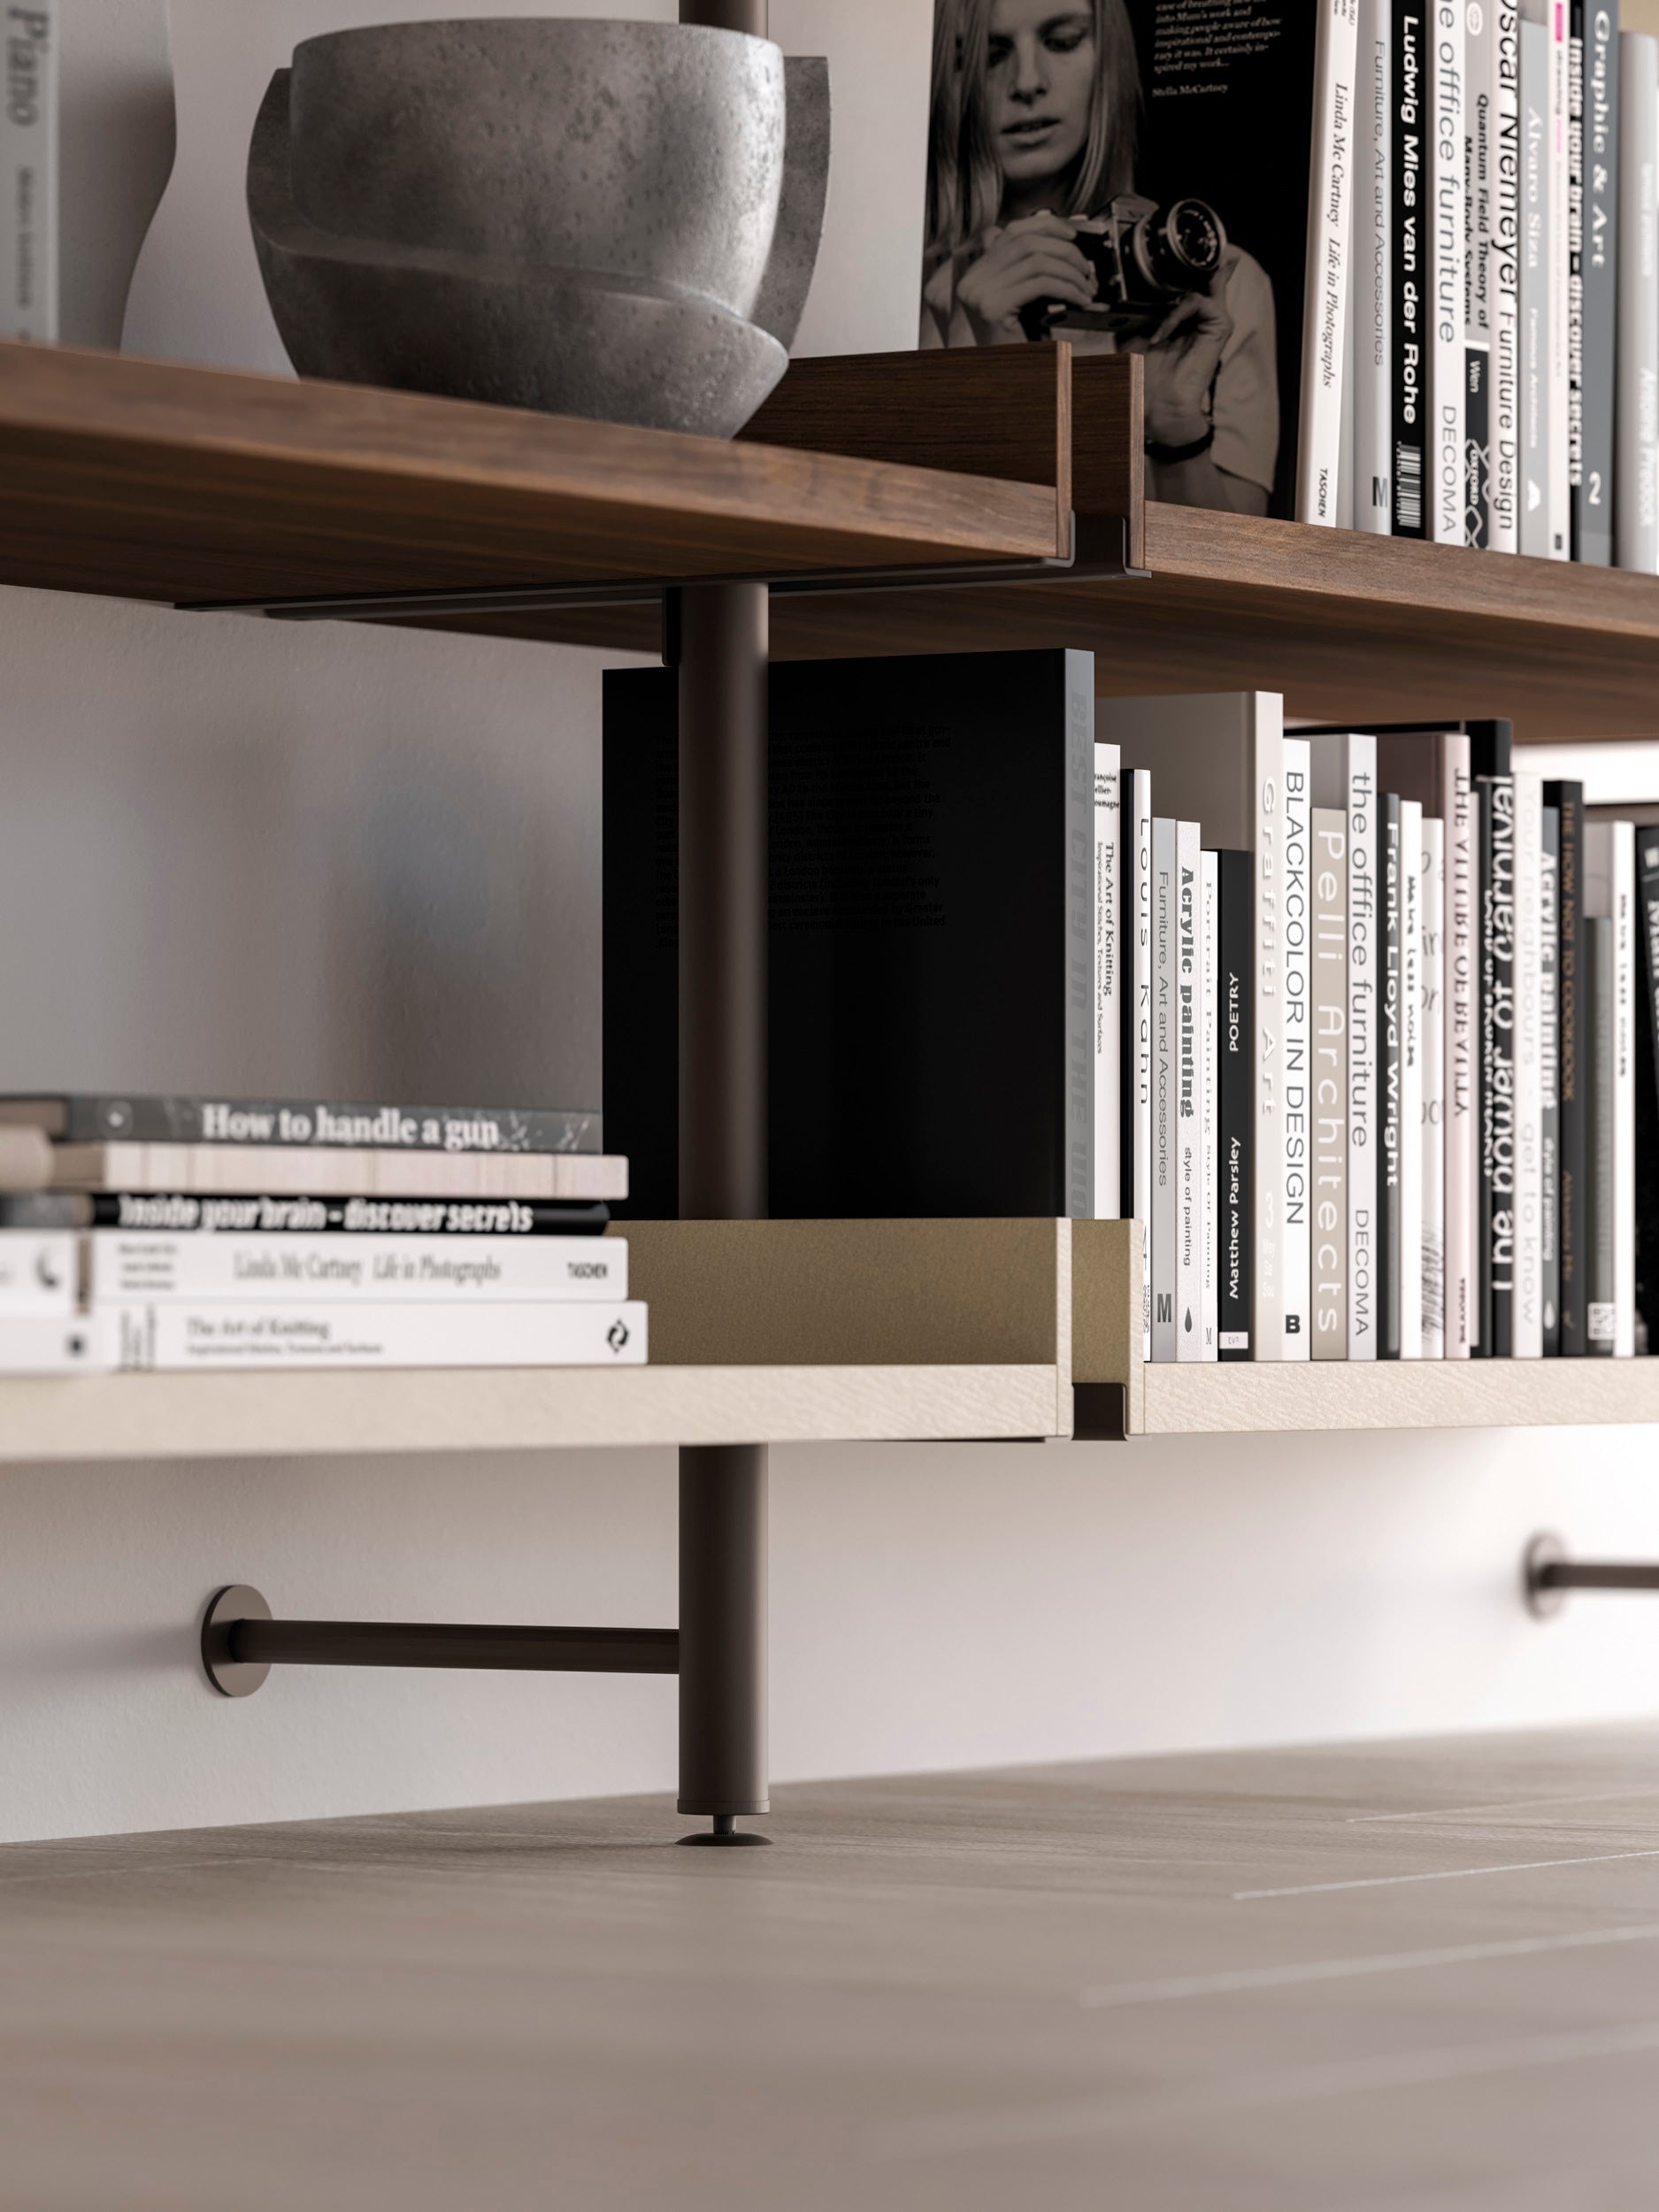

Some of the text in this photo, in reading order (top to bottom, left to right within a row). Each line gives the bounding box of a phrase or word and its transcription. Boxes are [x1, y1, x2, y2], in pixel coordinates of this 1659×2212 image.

[1333, 82, 1348, 130] Linda
[1439, 42, 1460, 162] office
[1591, 10, 1610, 269] Graphic & Art
[1326, 163, 1345, 227] Cartney
[1328, 237, 1341, 268] Life
[1374, 41, 1386, 366] Furniture, Art and Accessories
[1401, 15, 1419, 425] Ludwig Mies van der Rohe
[1475, 93, 1490, 329] Quantum Field Theory of
[1327, 269, 1340, 286] in
[1439, 175, 1460, 343] furniture
[1321, 290, 1339, 388] Photographs
[1469, 360, 1480, 393] Wen
[1499, 311, 1515, 431] Furniture
[1317, 467, 1329, 518] TASCHEN
[1442, 404, 1457, 533] DECOMA
[1469, 449, 1479, 506] OXFORD
[1493, 439, 1515, 531] Design
[1588, 471, 1602, 506] 2
[1103, 841, 1114, 996] The Art of Knitting
[1262, 776, 1276, 1115] Graffiti Art
[1352, 772, 1371, 1147] the office furniture
[1158, 871, 1169, 1187] Furniture, Art and Accessories
[1179, 866, 1194, 1118] Acrylic painting
[1229, 972, 1240, 1052] POETRY
[1286, 772, 1304, 1225] BLACKCOLOR IN DESIGN
[1384, 822, 1399, 1187] Frank Lloyd Wright
[203, 1104, 500, 1151] How to handle a gun
[1317, 830, 1345, 1333] Pelli Architects
[1183, 1147, 1192, 1267] style of painting
[1229, 1137, 1241, 1300] Matthew Parsley
[419, 1255, 502, 1286] Photographs
[1156, 1294, 1172, 1323] M
[1286, 1315, 1301, 1334] B
[1355, 1210, 1369, 1336] DECOMA
